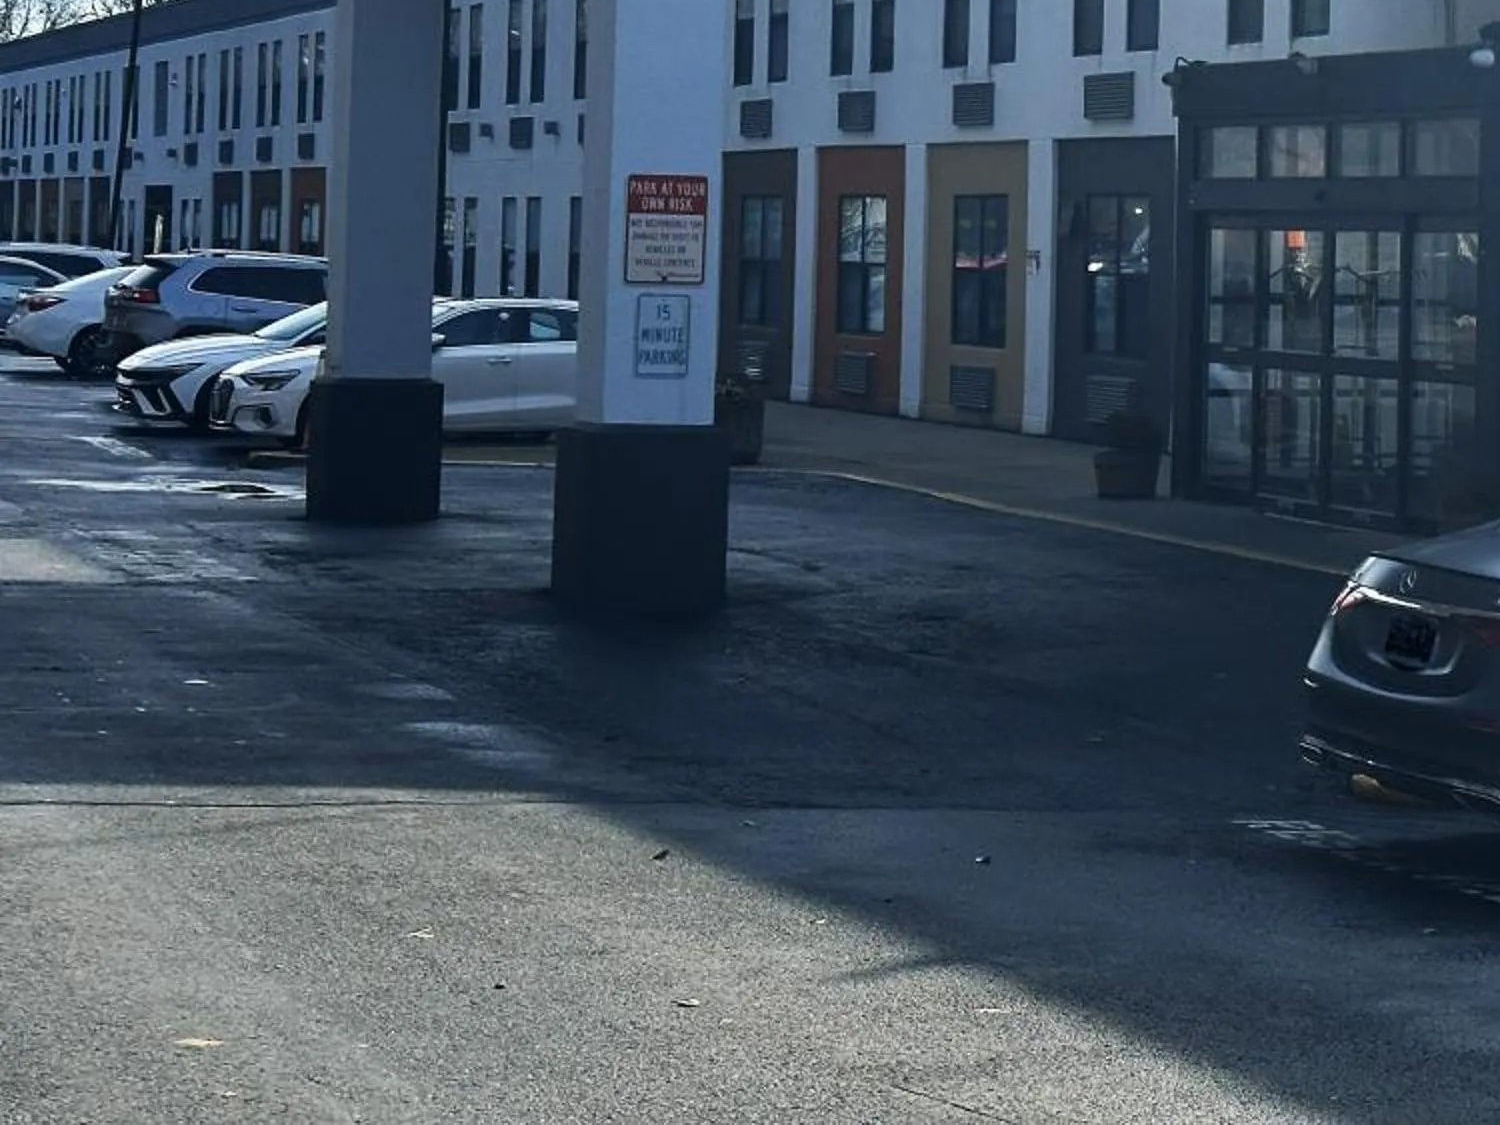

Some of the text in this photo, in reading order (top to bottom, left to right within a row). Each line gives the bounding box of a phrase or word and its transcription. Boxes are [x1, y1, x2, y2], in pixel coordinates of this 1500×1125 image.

[630, 179, 705, 197] PARK AT YOUR
[641, 196, 693, 212] OWN RISK
[656, 303, 671, 320] 15
[641, 327, 684, 344] MINUTE
[639, 348, 686, 365] PARKING
